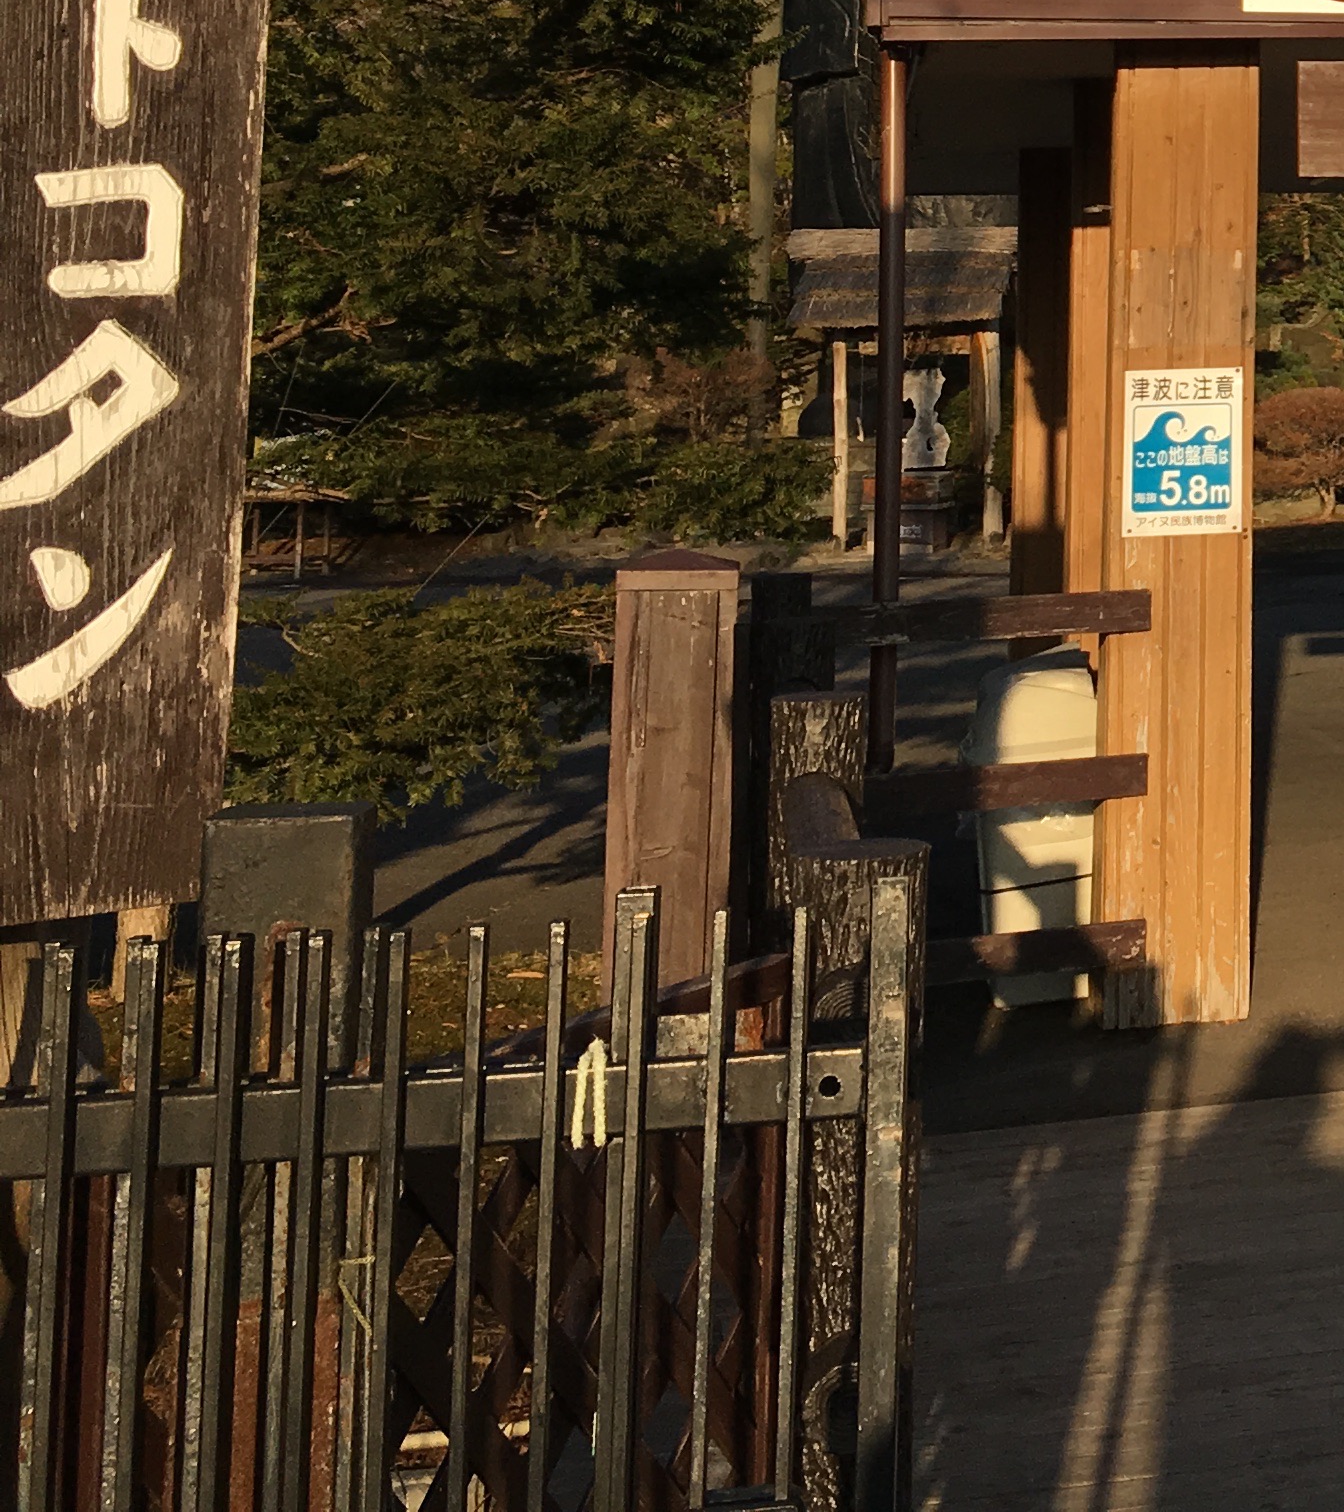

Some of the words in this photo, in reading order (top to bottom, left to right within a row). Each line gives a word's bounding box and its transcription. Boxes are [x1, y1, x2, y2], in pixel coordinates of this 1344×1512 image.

[1130, 375, 1235, 402] 津波に注意
[1135, 444, 1229, 468] ここの地盤高は
[1159, 469, 1231, 507] 5.8m
[1135, 514, 1227, 529] アイヌ民族博物館
